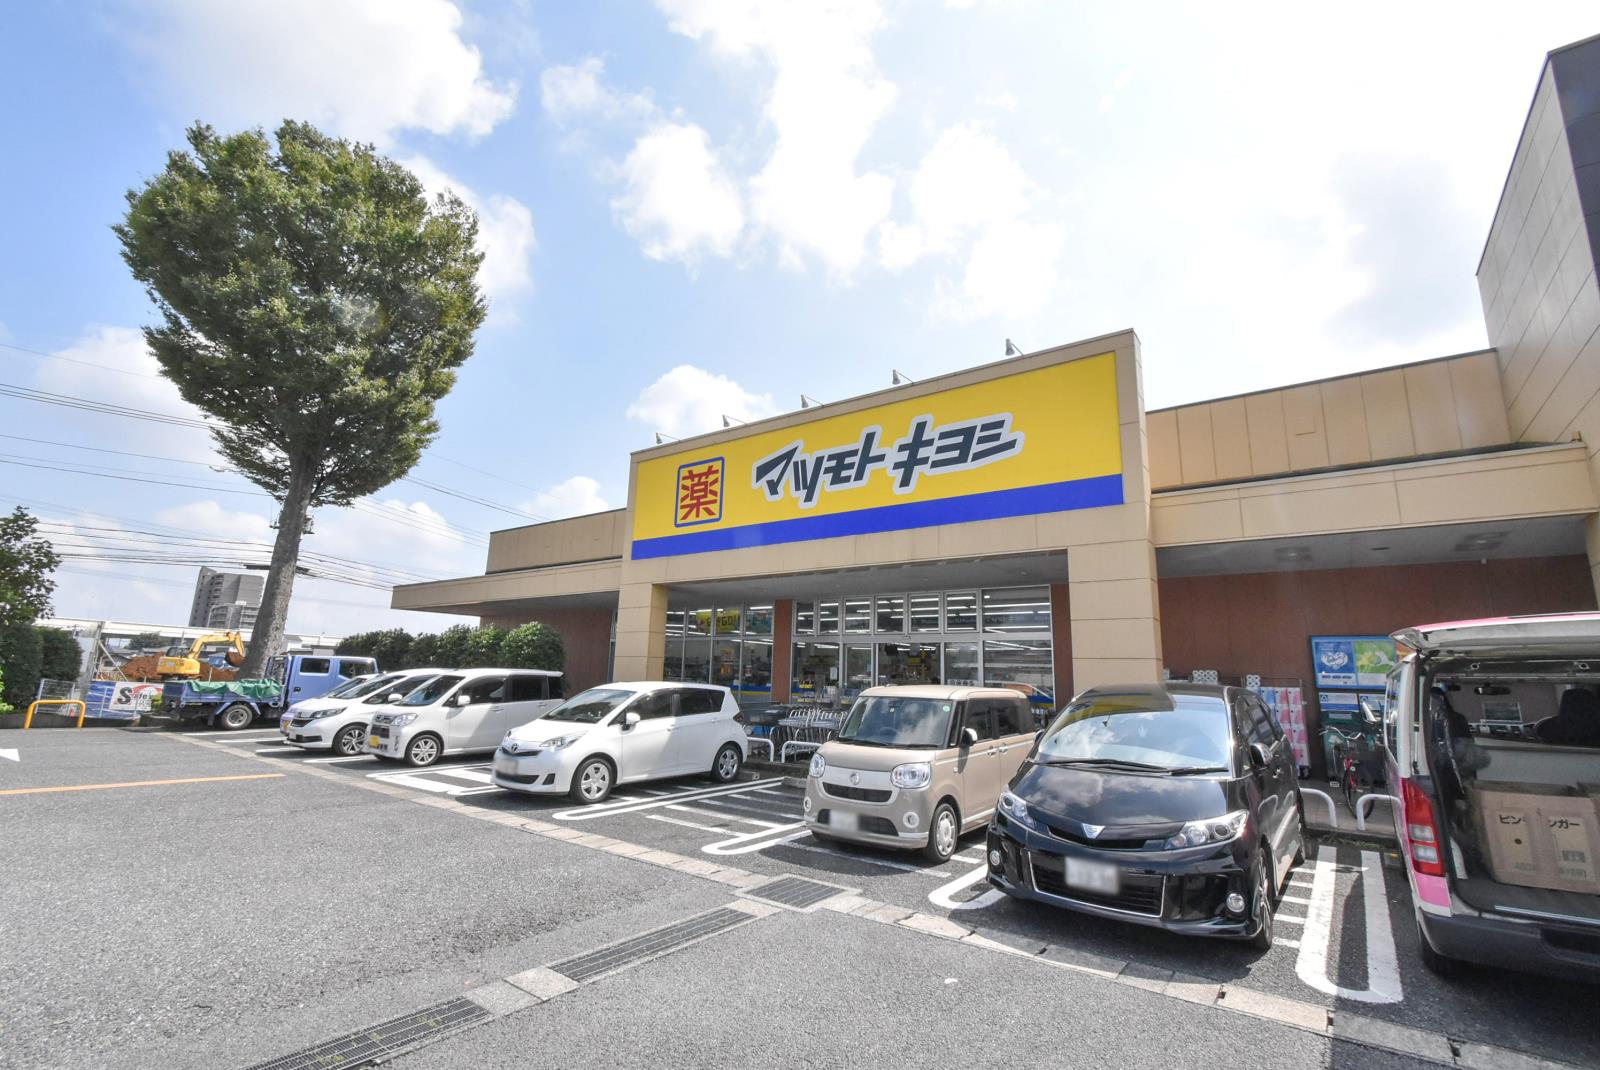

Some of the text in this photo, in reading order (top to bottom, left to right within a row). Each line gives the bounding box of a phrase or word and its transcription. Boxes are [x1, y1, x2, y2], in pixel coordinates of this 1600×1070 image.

[679, 465, 719, 521] 薬
[755, 418, 1019, 503] マツモトキヨシ
